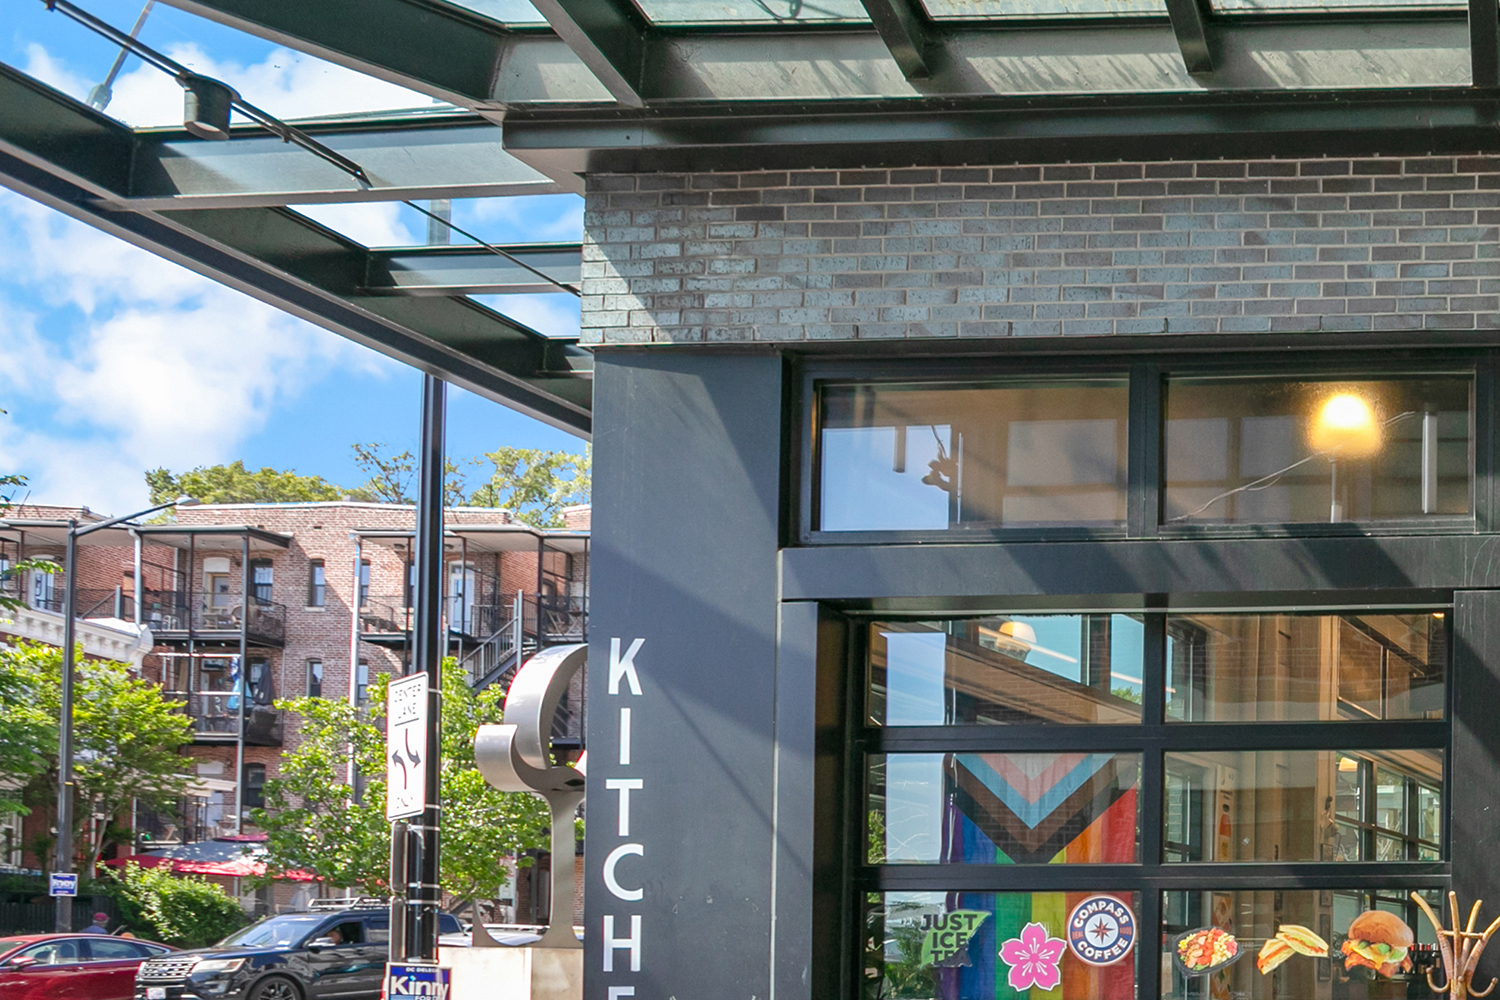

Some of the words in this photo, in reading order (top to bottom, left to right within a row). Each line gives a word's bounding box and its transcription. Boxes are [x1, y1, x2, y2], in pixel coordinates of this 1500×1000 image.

[920, 914, 978, 931] JUST
[1073, 900, 1129, 928] COMPASS
[932, 932, 968, 949] ICE
[1077, 937, 1129, 960] COFFEE
